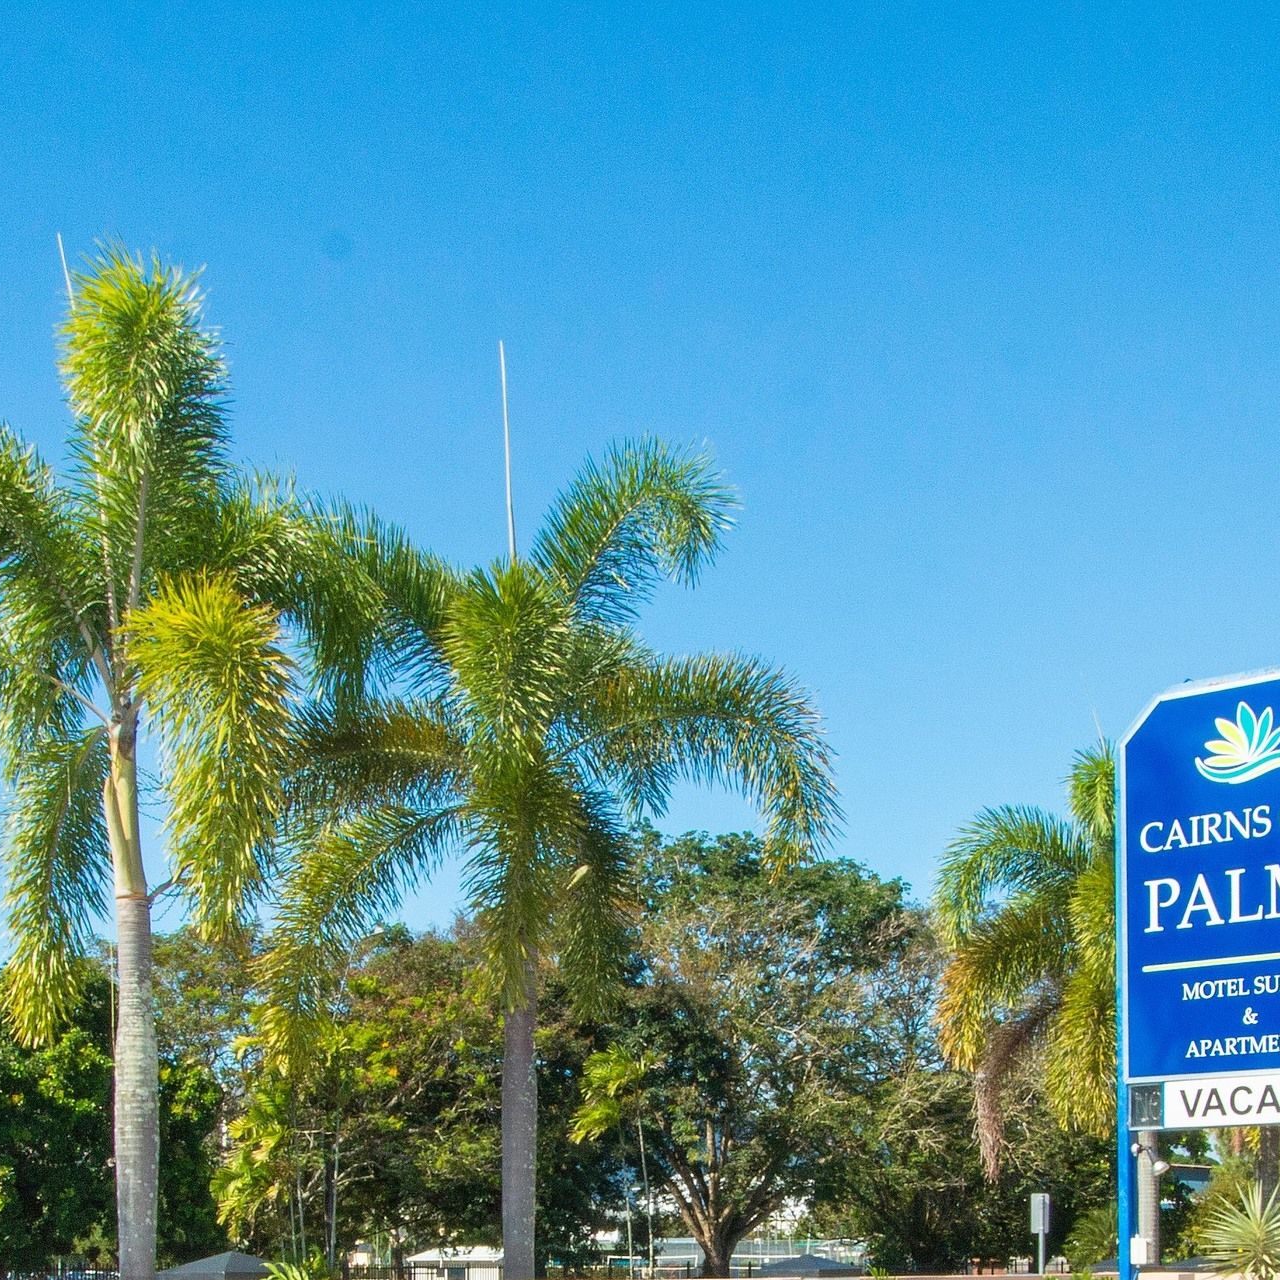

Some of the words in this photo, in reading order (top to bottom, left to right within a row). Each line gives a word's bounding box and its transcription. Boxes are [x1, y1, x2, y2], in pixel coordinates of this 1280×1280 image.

[1139, 804, 1272, 854] CAIRNS
[1181, 978, 1250, 1001] MOTEL
[1242, 1007, 1259, 1026] &
